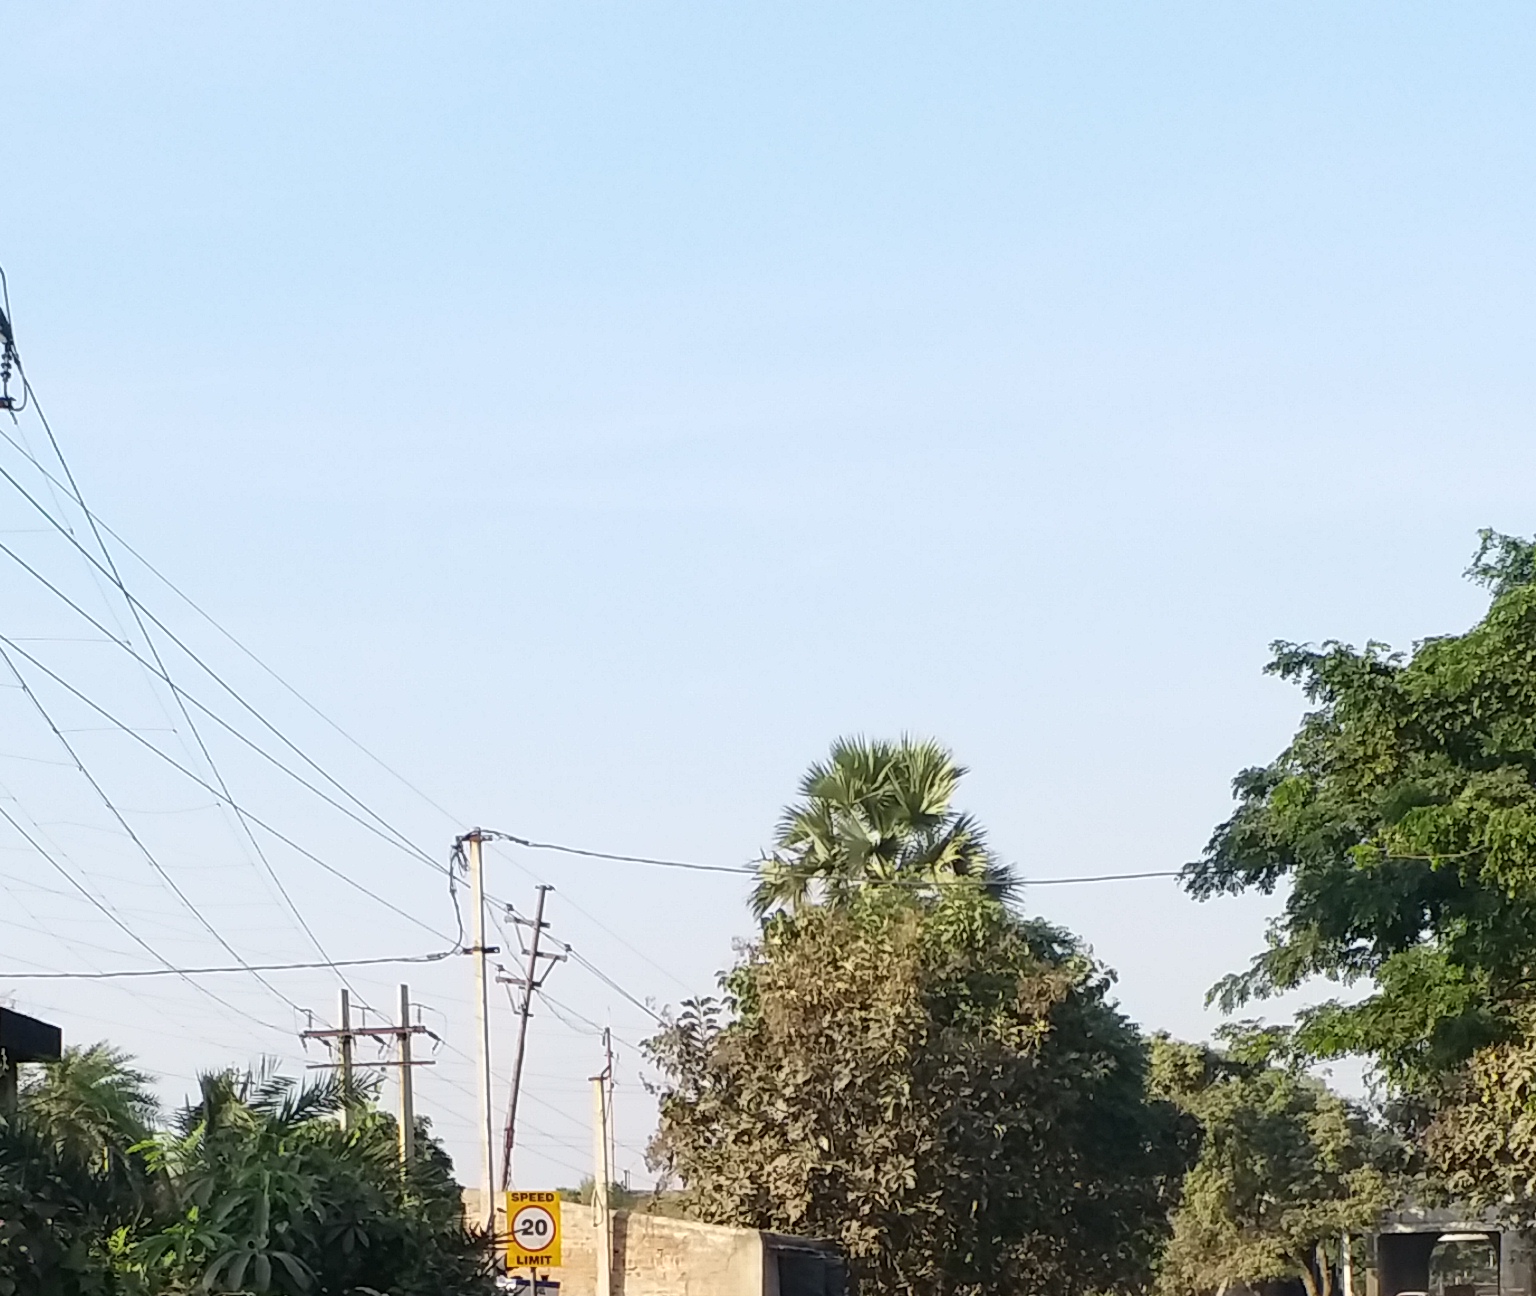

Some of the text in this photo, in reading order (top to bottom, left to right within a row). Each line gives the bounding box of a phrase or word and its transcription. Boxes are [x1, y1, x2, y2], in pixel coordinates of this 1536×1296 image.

[511, 1192, 555, 1202] SPEED
[521, 1219, 548, 1236] 20
[516, 1256, 552, 1265] LIMIT
